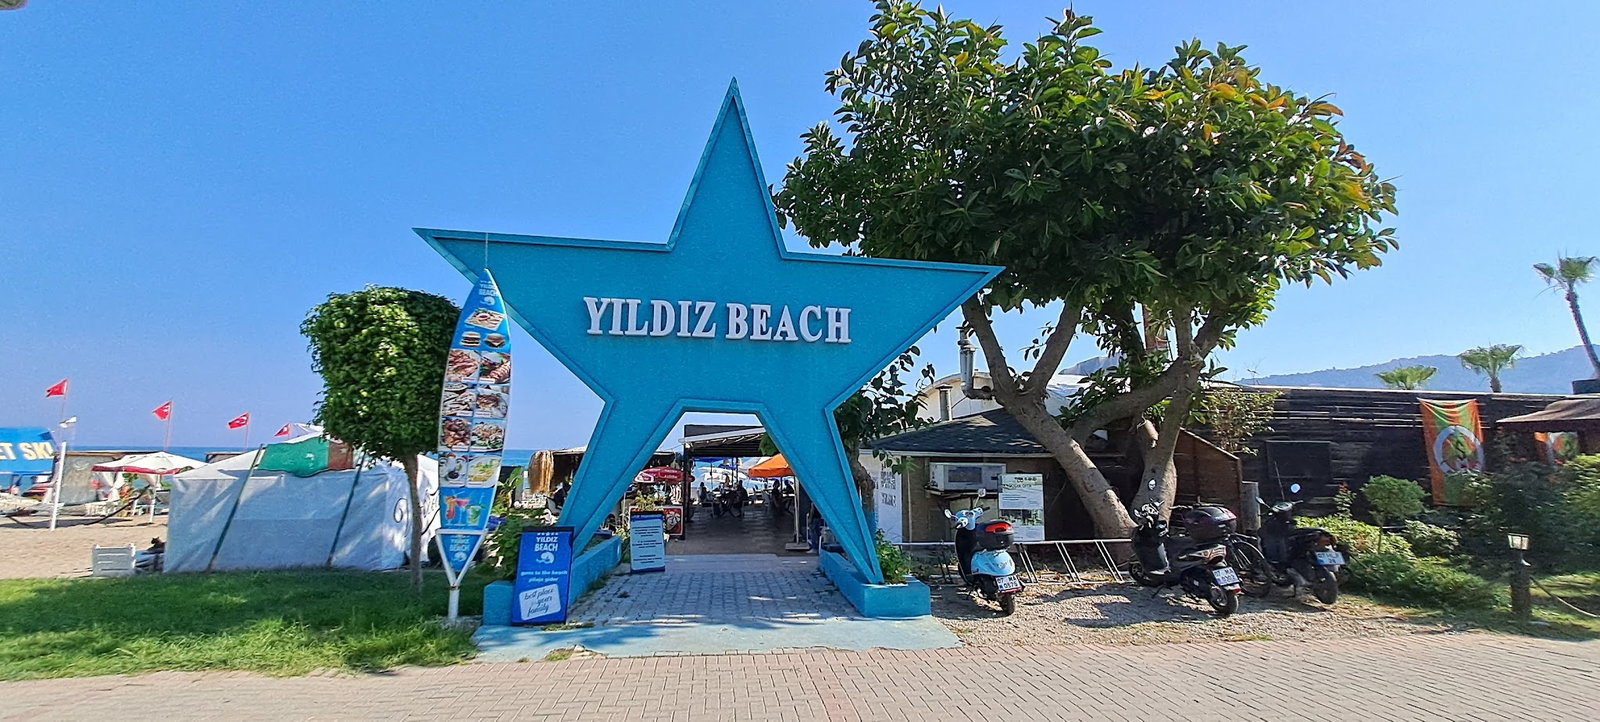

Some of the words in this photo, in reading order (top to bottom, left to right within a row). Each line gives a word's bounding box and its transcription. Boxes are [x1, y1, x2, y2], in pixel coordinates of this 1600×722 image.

[583, 296, 717, 338] YILDIZ
[726, 303, 851, 343] BEACH
[534, 543, 558, 552] BEACH
[525, 590, 537, 600] best
